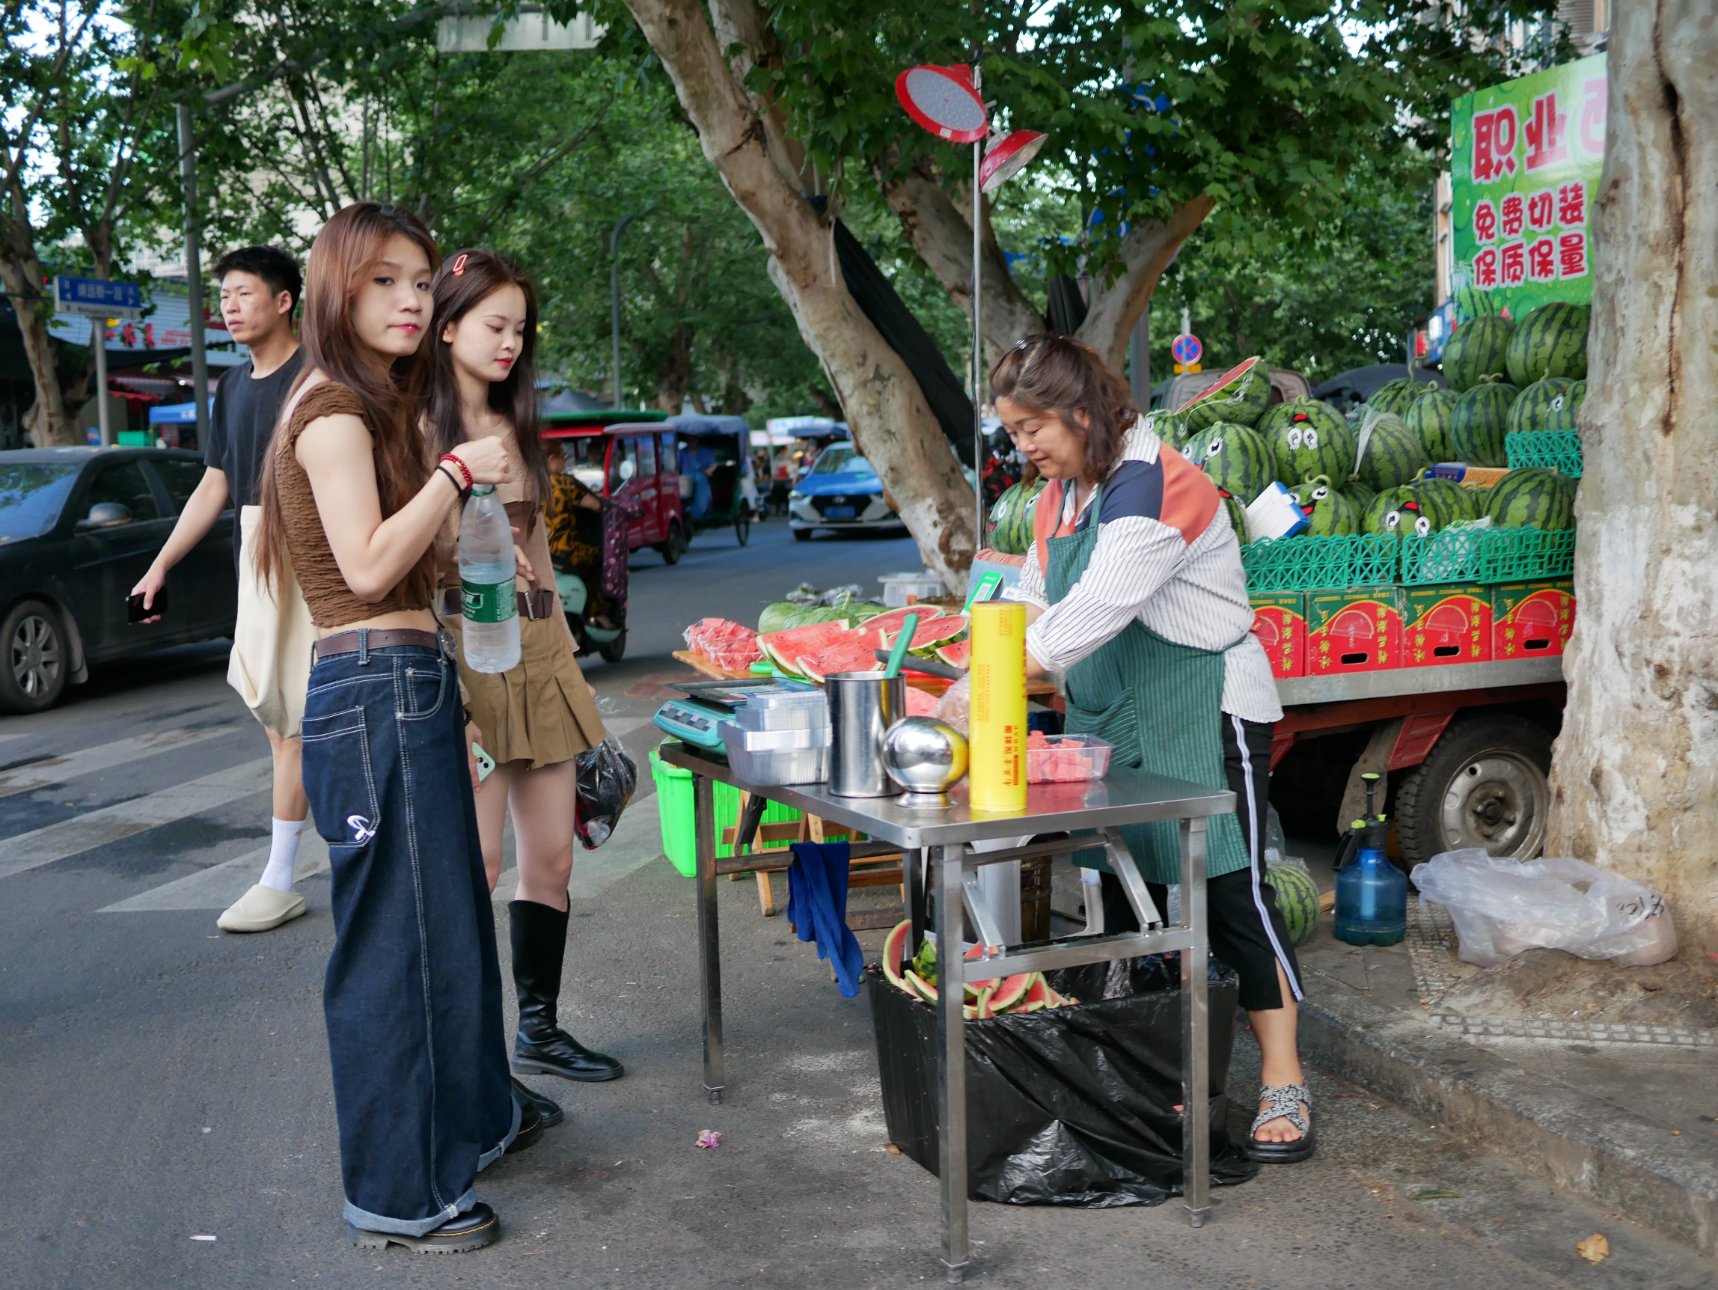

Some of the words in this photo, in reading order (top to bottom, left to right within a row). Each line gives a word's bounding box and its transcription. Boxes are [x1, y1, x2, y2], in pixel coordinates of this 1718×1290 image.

[1475, 183, 1585, 242] 免费切装
[1475, 233, 1585, 286] 保质保量
